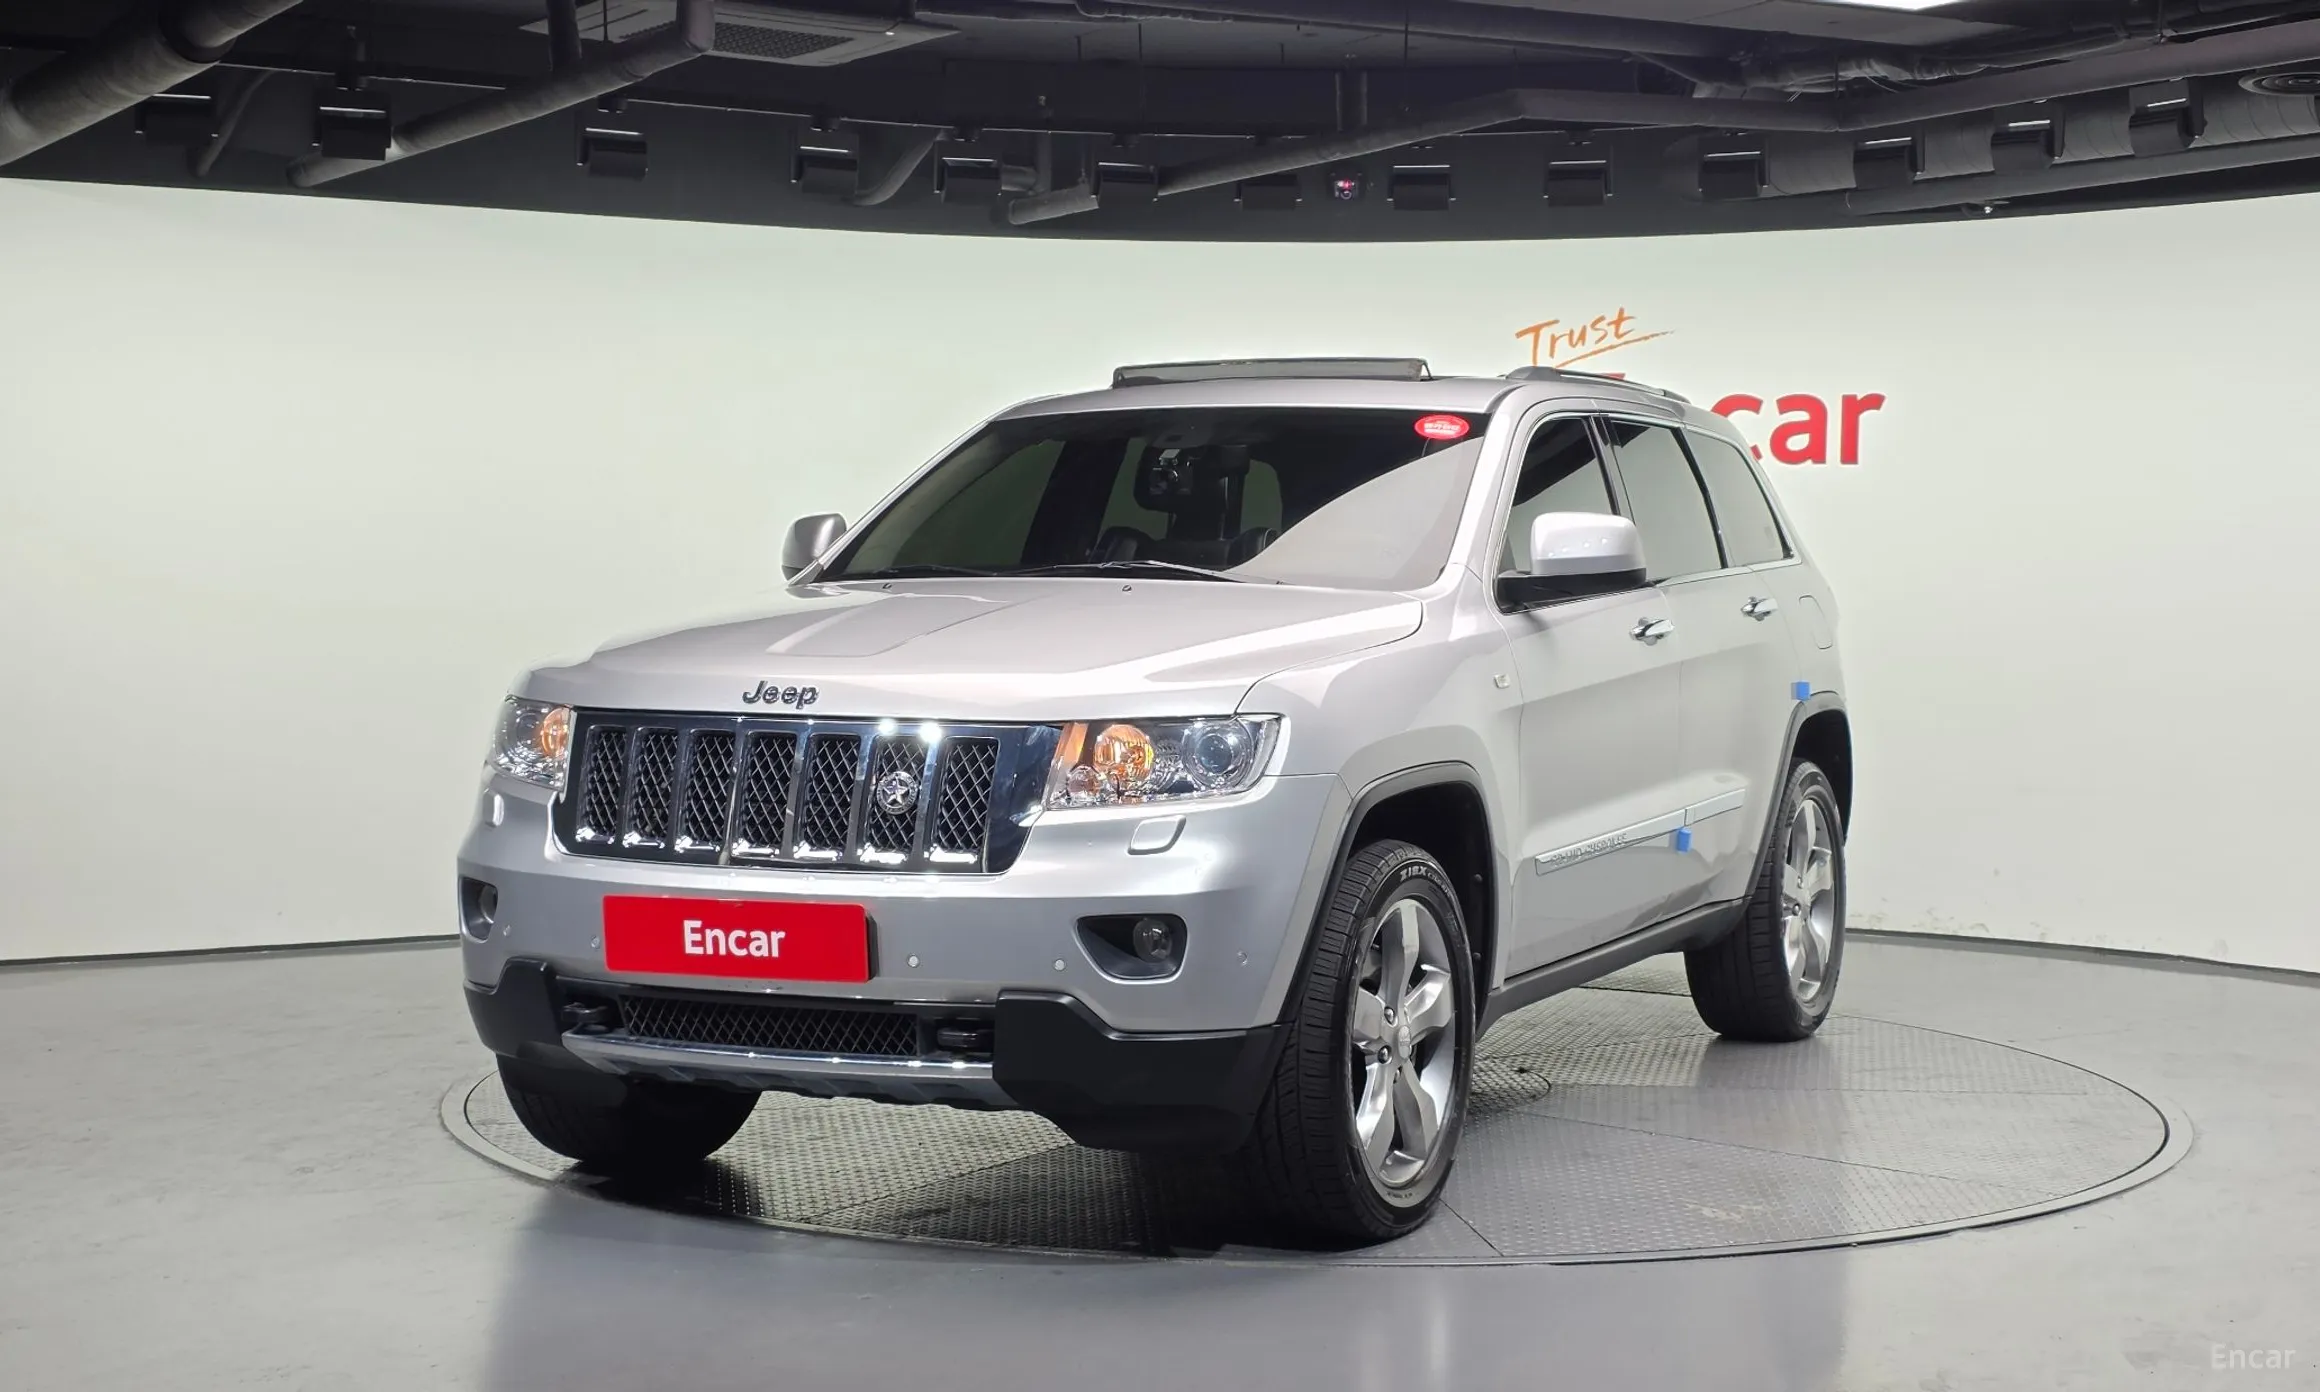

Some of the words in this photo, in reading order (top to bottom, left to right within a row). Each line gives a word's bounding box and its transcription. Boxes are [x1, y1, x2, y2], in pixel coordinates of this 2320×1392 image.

[1514, 307, 1637, 366] Trust
[742, 680, 819, 709] Jeep
[683, 919, 786, 957] Encar
